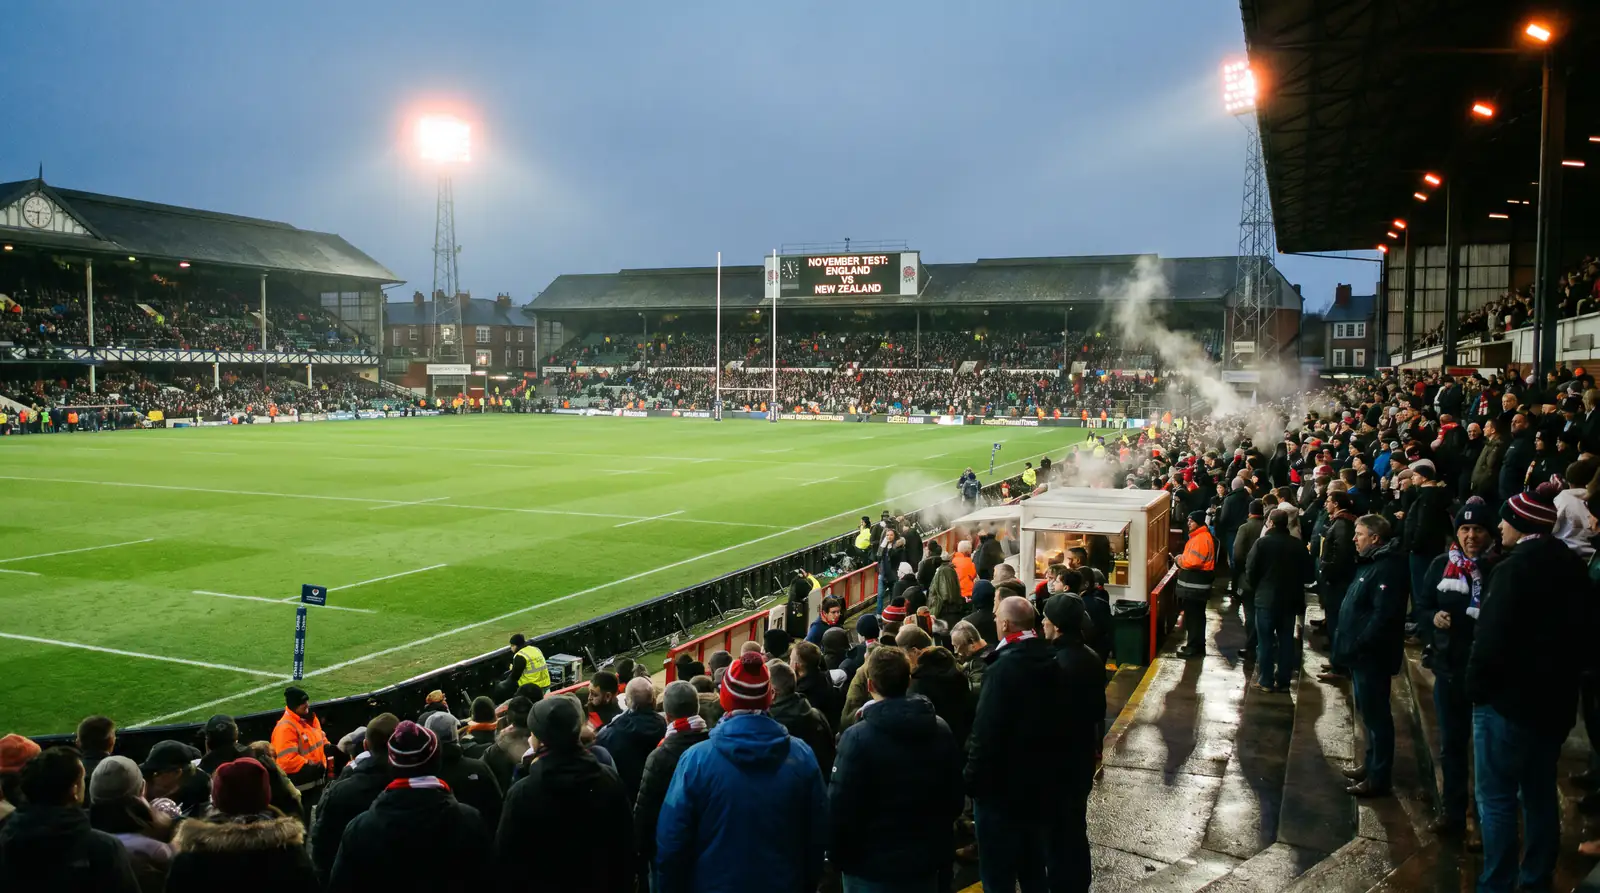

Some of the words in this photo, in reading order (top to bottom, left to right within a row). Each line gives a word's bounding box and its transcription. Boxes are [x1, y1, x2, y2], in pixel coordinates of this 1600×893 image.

[808, 256, 860, 267] NOVEMBER
[862, 256, 889, 265] TEST:
[825, 266, 871, 276] ENGLAND
[841, 275, 854, 284] VS
[814, 284, 836, 294] NEW
[837, 283, 882, 294] ZEALAND
